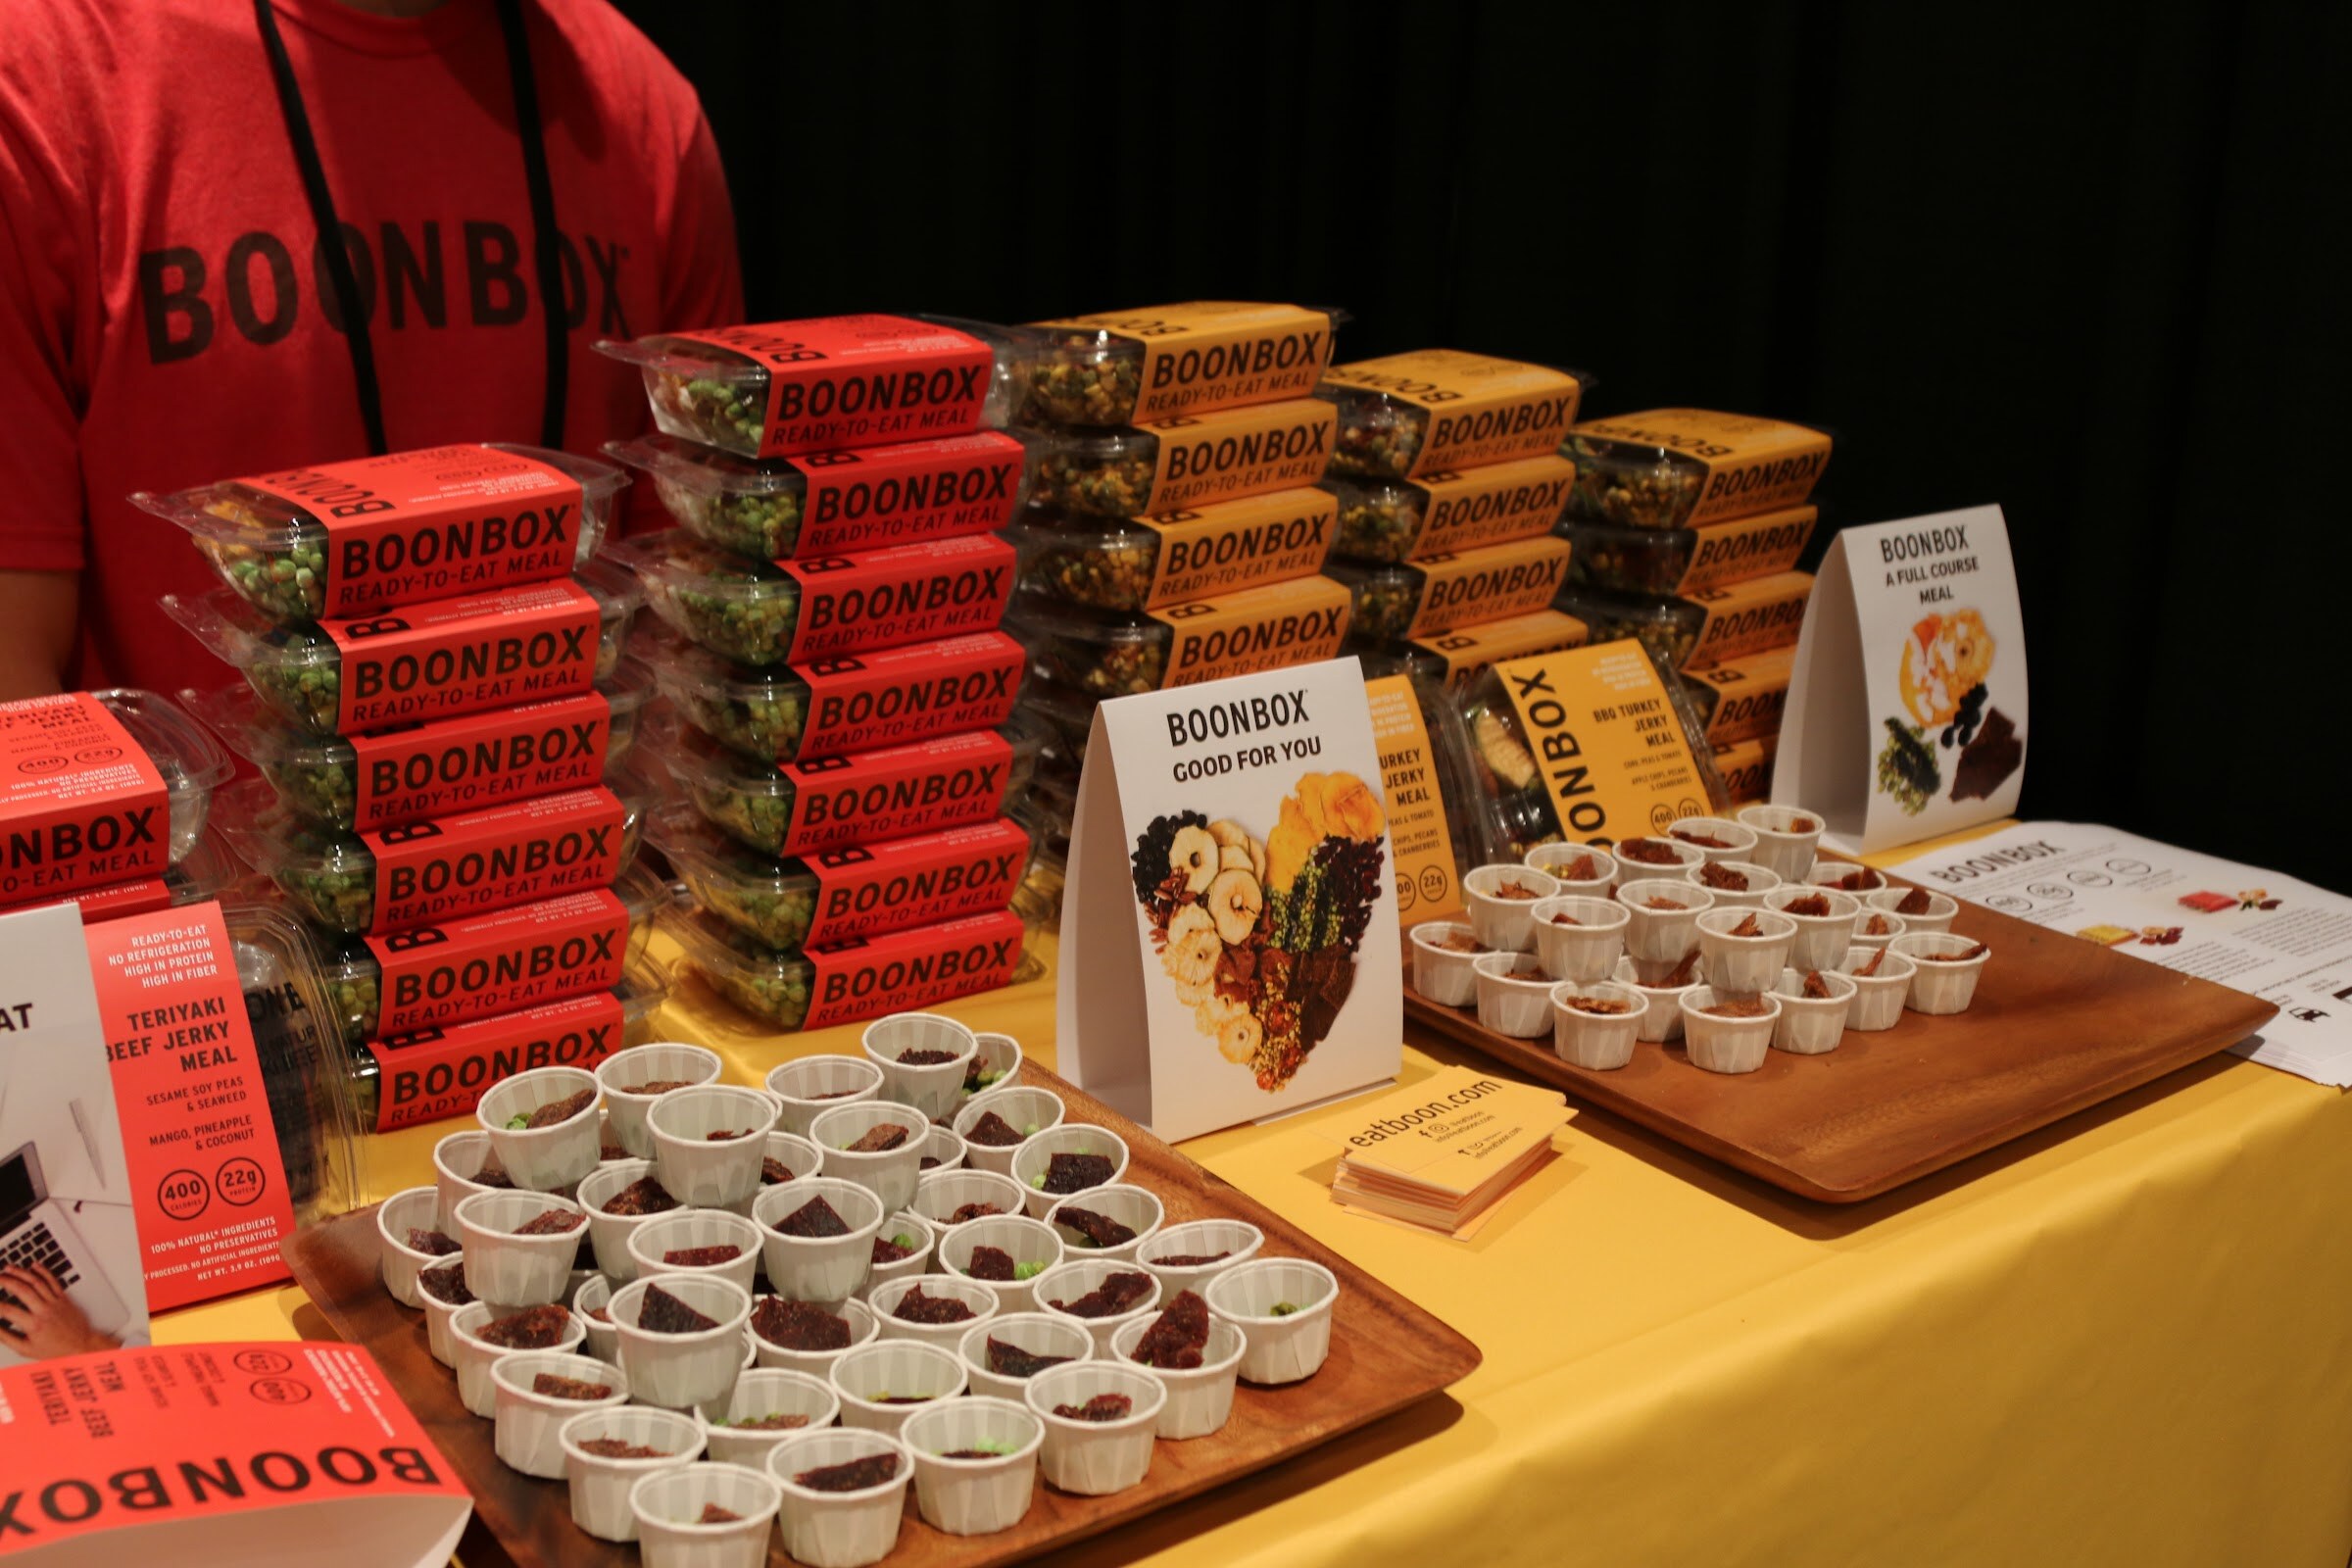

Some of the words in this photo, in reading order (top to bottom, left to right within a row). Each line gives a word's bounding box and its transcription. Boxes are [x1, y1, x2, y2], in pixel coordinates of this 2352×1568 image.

[1152, 331, 1321, 389] BOONBOX
[1269, 371, 1310, 390] MEAL
[778, 365, 981, 421] BOONBOX
[773, 414, 912, 446] READY-TO-EAT
[919, 408, 968, 428] MEAL
[1432, 396, 1570, 450] BOONBOX
[1166, 420, 1330, 481] BOONBOX
[1278, 463, 1318, 479] MEAL
[814, 464, 1011, 524] BOONBOX
[1430, 478, 1567, 532] BOONBOX
[342, 503, 571, 580] BOONBOX
[808, 512, 945, 548] READY-TO-EAT
[954, 504, 1002, 526] MEAL
[1166, 513, 1329, 576] BOONBOX
[1881, 525, 1970, 564] BOONBOX
[339, 561, 498, 605] READY-TO-EAT
[507, 549, 563, 573] MEAL
[1277, 550, 1316, 570] MEAL
[1886, 572, 1895, 587] A
[1898, 566, 1928, 584] FULL
[1931, 557, 1980, 579] COURSE
[808, 565, 1004, 631] BOONBOX
[1427, 556, 1563, 611] BOONBOX
[1920, 585, 1955, 605] MEAL
[803, 613, 938, 653] READY-TO-EAT
[945, 606, 993, 628] MEAL
[1180, 605, 1344, 668] BOONBOX
[355, 624, 587, 700] BOONBOX
[1291, 642, 1332, 664] MEAL
[353, 677, 520, 722] READY-TO-EAT
[523, 667, 581, 691] MEAL
[817, 665, 1014, 731] BOONBOX
[1593, 707, 1617, 723] BBQ
[1619, 698, 1661, 717] TURKEY
[811, 714, 946, 752] READY-TO-EAT
[953, 704, 1001, 723] MEAL
[1166, 689, 1309, 748] BOONBOX
[1636, 714, 1667, 733] JERKY
[371, 720, 597, 798] BOONBOX
[1173, 754, 1233, 783] GOOD
[1237, 745, 1278, 769] FOR
[1281, 736, 1323, 761] YOU
[1645, 731, 1676, 748] MEAL
[368, 774, 523, 820] READY-TO-EAT
[538, 760, 592, 784] MEAL
[803, 762, 1001, 826] BOONBOX
[1386, 767, 1425, 789] JERKY
[1396, 787, 1431, 808] MEAL
[798, 806, 932, 848] READY-TO-EAT
[941, 800, 989, 820] MEAL
[1654, 812, 1673, 824] 400
[89, 850, 155, 877] MEAL
[389, 823, 612, 903] BOONBOX
[1423, 875, 1443, 888] 22g
[1929, 840, 2060, 883] BOONBOX
[386, 875, 544, 923] READY-TO-EAT
[550, 862, 605, 889] MEAL
[826, 854, 1016, 919] BOONBOX
[820, 901, 951, 939] READY-TO-EAT
[957, 889, 1004, 908] MEAL
[109, 956, 124, 966] NO
[127, 938, 211, 962] REFRIGERATION
[131, 924, 207, 948] READY-TO-EAT
[124, 963, 151, 977] HIGH
[155, 960, 166, 970] IN
[169, 952, 214, 968] PROTEIN
[142, 974, 170, 988] HIGH
[172, 971, 183, 982] IN
[186, 964, 218, 979] FIBER
[395, 929, 615, 1007] BOONBOX
[822, 938, 1012, 1004] BOONBOX
[126, 997, 225, 1031] TERIYAKI
[392, 980, 547, 1028] READY-TO-EAT
[555, 965, 610, 990] MEAL
[816, 983, 948, 1023] READY-TO-EAT
[955, 974, 1003, 993] MEAL
[164, 1021, 228, 1050] JERKY
[180, 1046, 238, 1072] MEAL
[393, 1023, 612, 1105] BOONBOX
[147, 1088, 189, 1105] SESAME
[192, 1083, 213, 1096] SOY
[217, 1076, 243, 1090] PEAS
[187, 1102, 194, 1112] &
[198, 1091, 247, 1109] SEAWEED
[149, 1130, 191, 1146] MANGO,
[194, 1114, 252, 1136] PINEAPPLE
[1348, 1079, 1503, 1149] eatboon.com
[195, 1140, 203, 1151] &
[206, 1128, 255, 1149] COCONUT
[165, 1180, 201, 1200] 400
[224, 1169, 257, 1188] 22g
[230, 1186, 256, 1197] PROTEIN
[151, 1241, 175, 1254] 100%
[221, 1216, 275, 1237] INGREDIENTS
[200, 1246, 212, 1254] NO
[214, 1228, 277, 1250] PRESERVATIVES
[198, 1271, 212, 1281] NET
[202, 1252, 237, 1267] ARTIFICIAL
[62, 1368, 97, 1402] JERKY
[94, 1361, 124, 1392] MEAL
[30, 1370, 72, 1428] TERIYAKI
